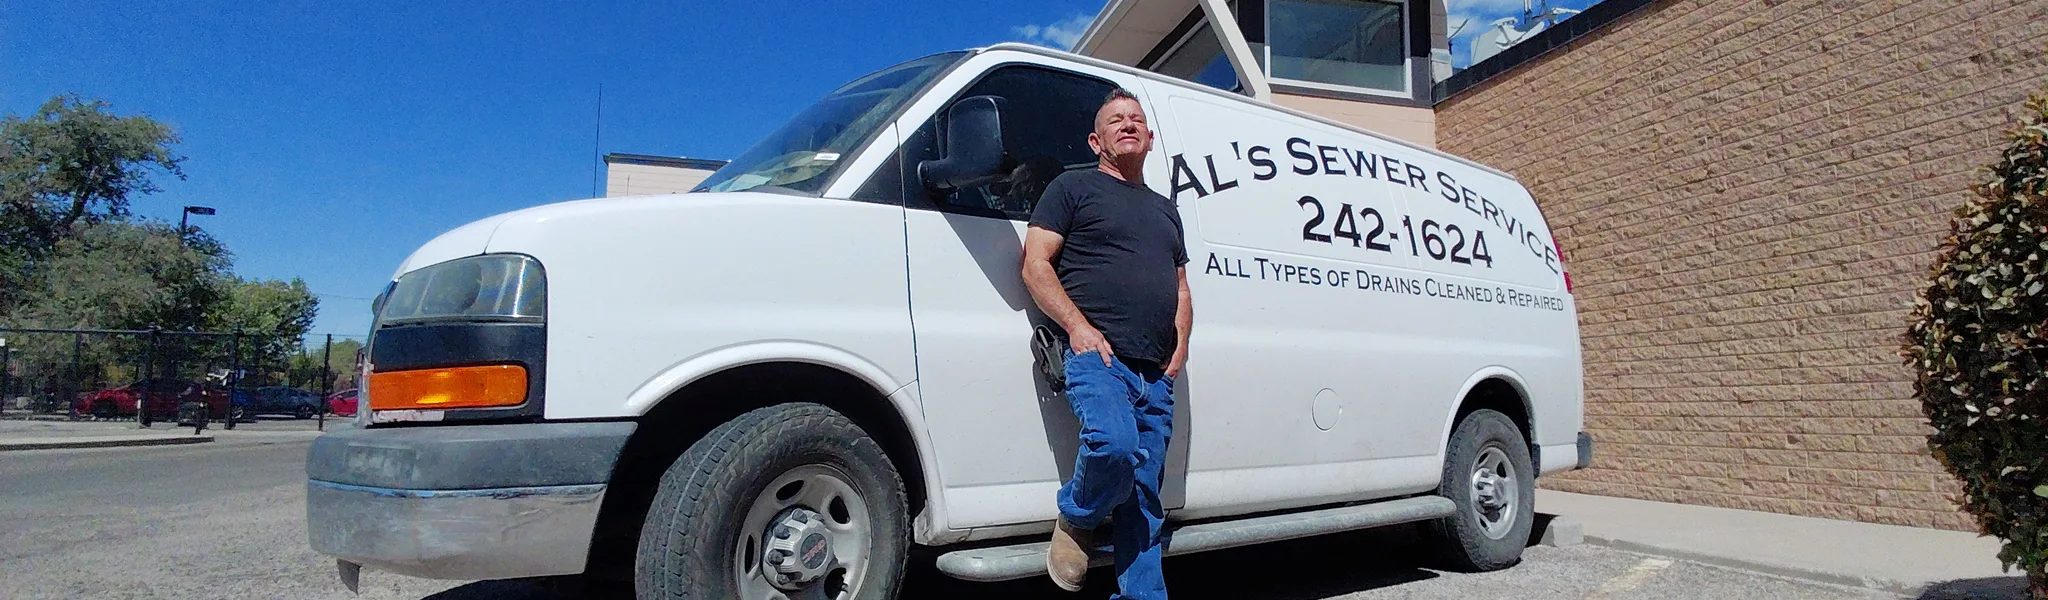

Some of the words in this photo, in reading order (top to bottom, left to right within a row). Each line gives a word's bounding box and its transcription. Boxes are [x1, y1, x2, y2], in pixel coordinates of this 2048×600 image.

[1170, 141, 1277, 207] AL'S
[1286, 137, 1431, 193] SEWER
[1437, 171, 1559, 275] SERVICE
[1297, 195, 1493, 268] 242-1624
[1205, 252, 1251, 279] ALL
[1254, 257, 1322, 286] TYPES
[1327, 269, 1350, 288] OF
[1356, 269, 1422, 296] DRAINS
[1425, 278, 1493, 303] CLEANED
[1496, 287, 1506, 304] &
[1508, 288, 1564, 312] REPAIRED
